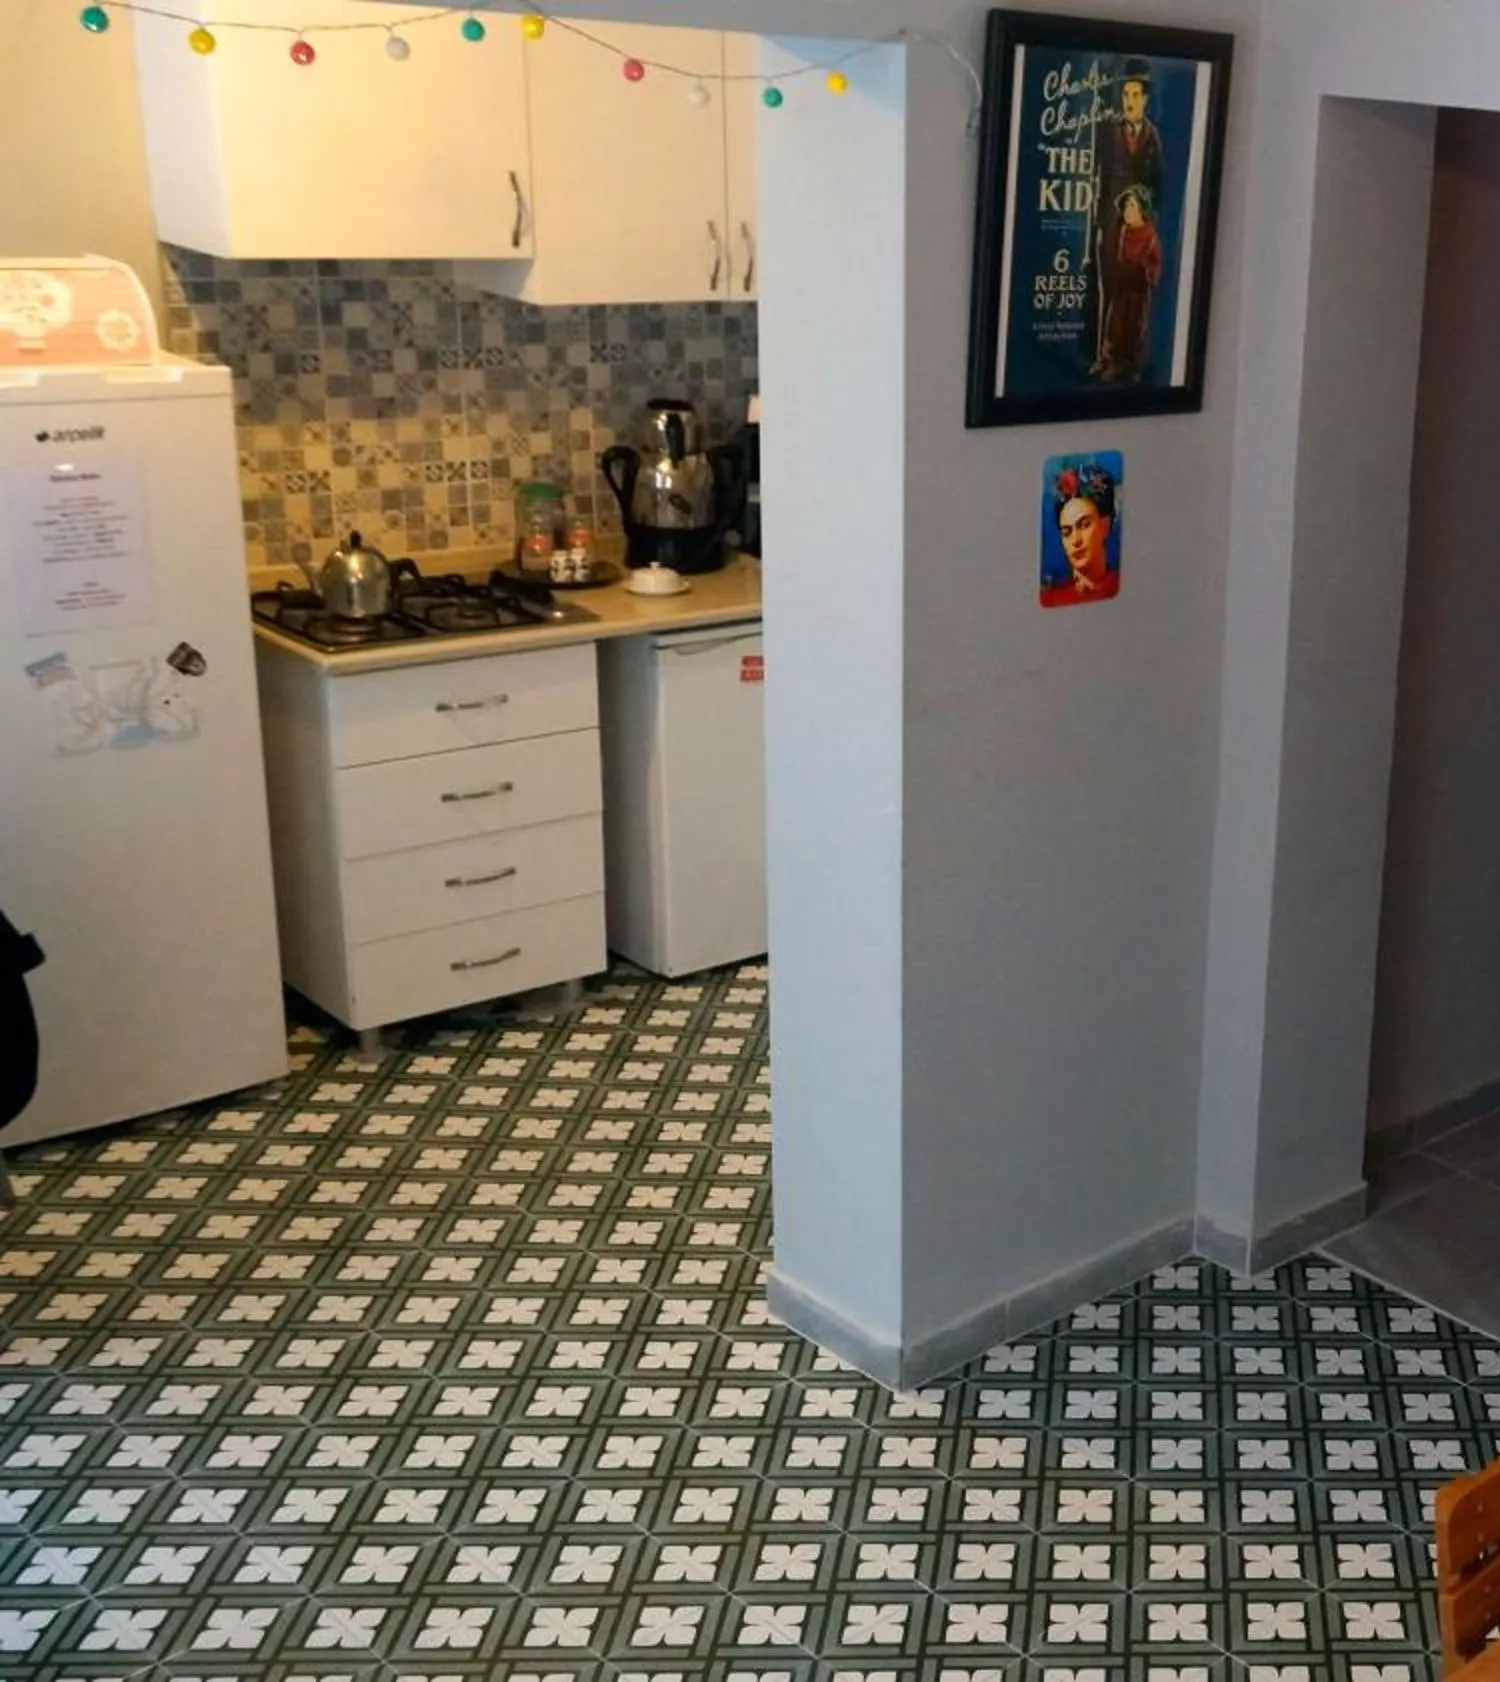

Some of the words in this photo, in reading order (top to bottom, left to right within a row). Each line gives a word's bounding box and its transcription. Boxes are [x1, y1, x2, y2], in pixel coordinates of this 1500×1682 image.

[1039, 178, 1093, 211] KID
[1053, 248, 1070, 273] 6
[1034, 275, 1088, 292] REELS
[1033, 293, 1054, 309] OF
[1056, 293, 1086, 309] JOY
